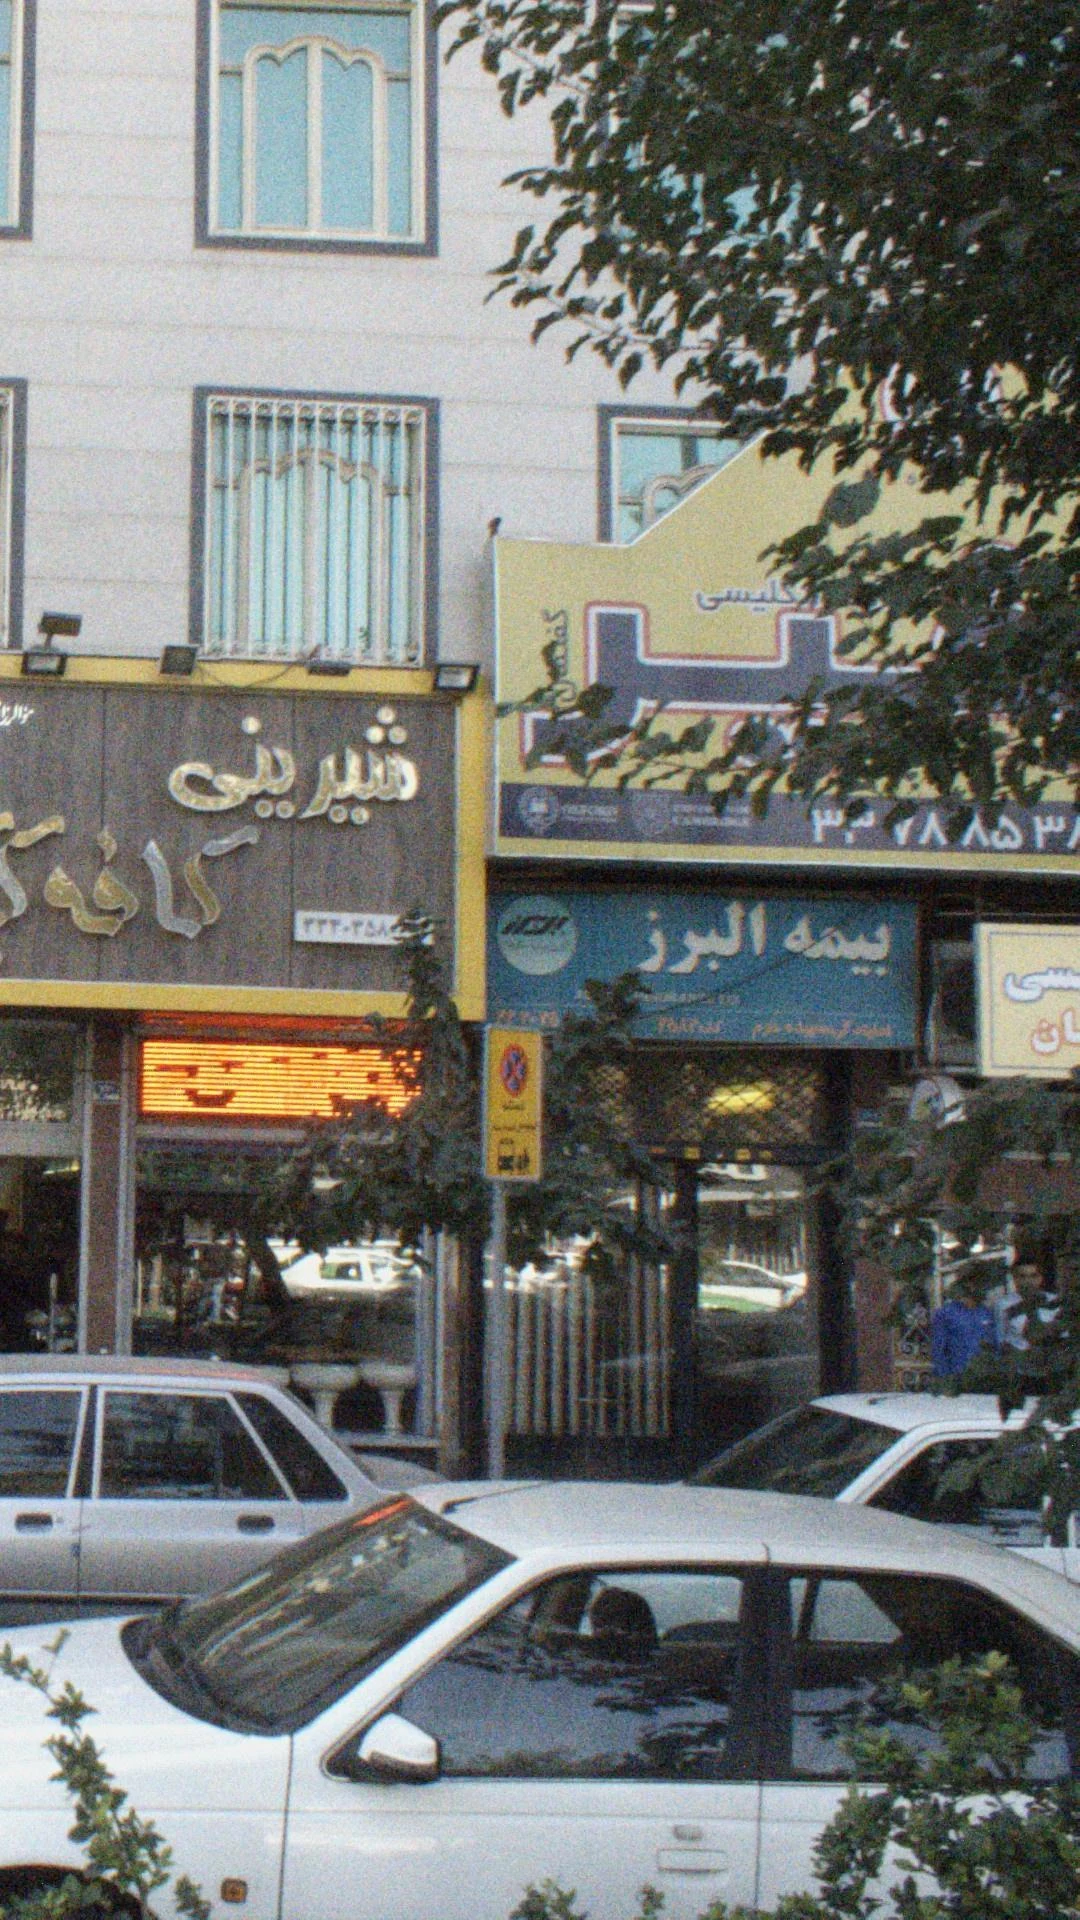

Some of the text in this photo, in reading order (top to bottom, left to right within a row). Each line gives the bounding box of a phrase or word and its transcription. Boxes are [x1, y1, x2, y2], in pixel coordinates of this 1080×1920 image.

[168, 706, 418, 825] شیرینی
[637, 901, 891, 976] بیمه البرز
